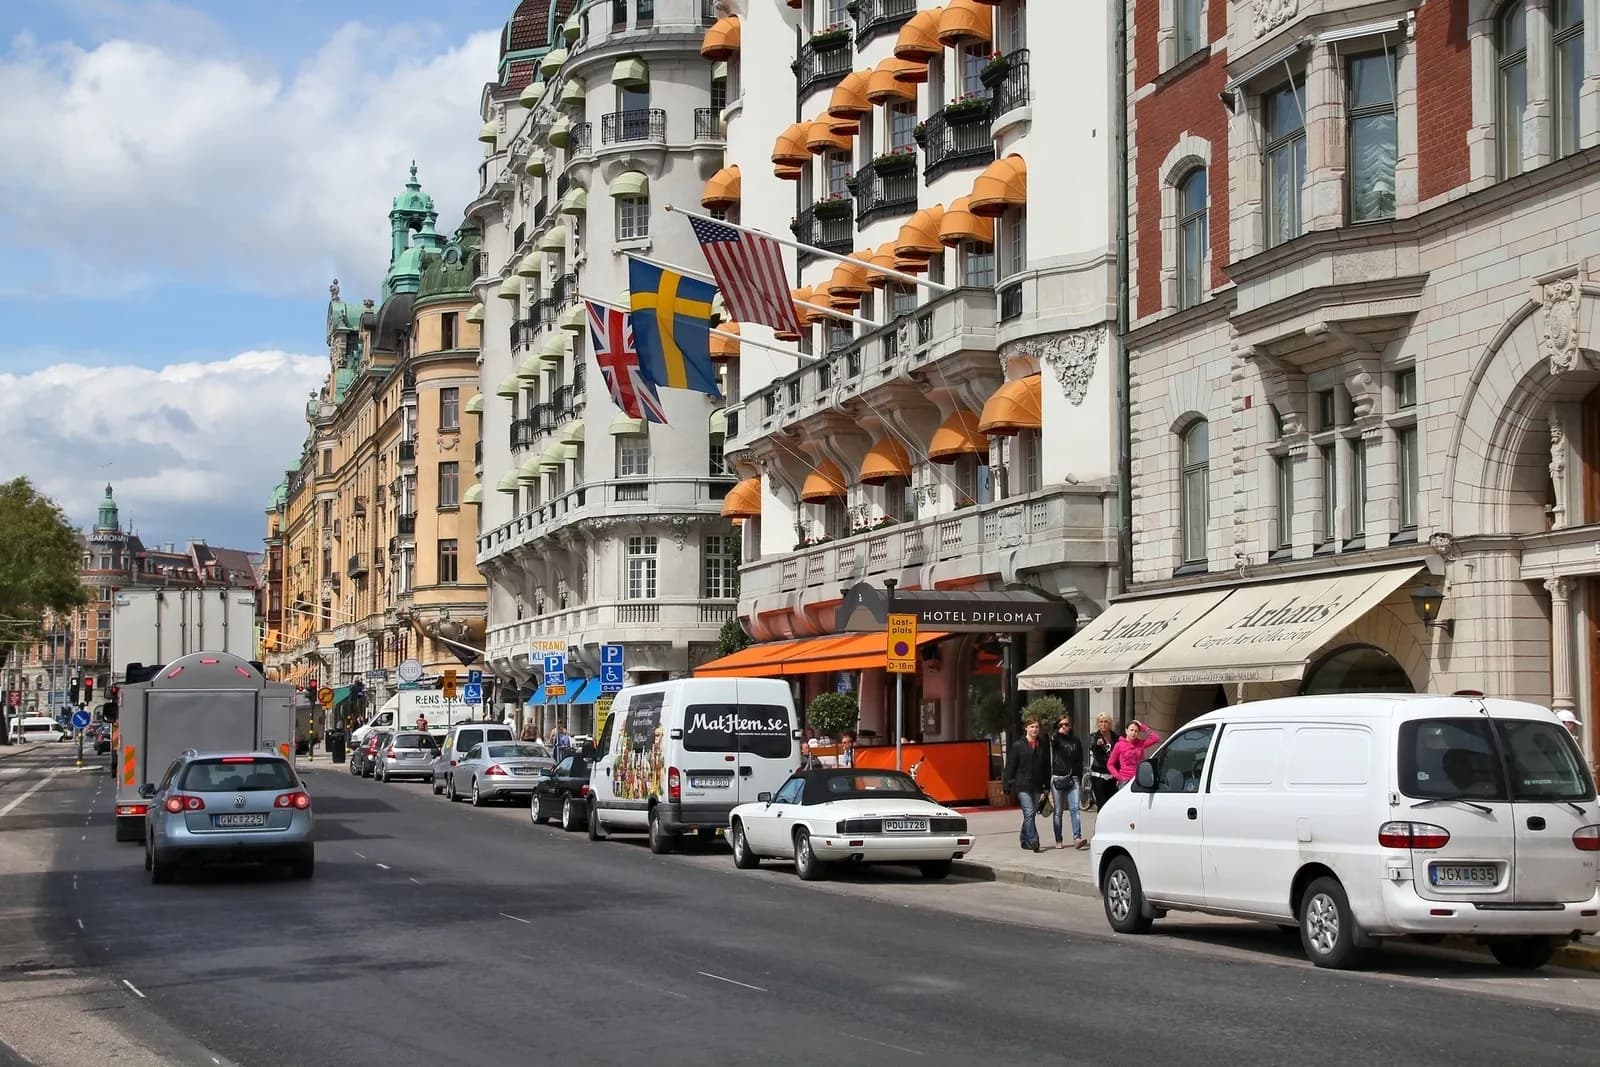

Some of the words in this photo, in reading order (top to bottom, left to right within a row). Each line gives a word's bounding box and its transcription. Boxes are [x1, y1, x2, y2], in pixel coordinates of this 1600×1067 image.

[923, 611, 967, 622] HOTEL
[972, 612, 1042, 623] DIPLOMAT
[532, 640, 565, 651] STRAND
[607, 647, 618, 662] P
[550, 658, 559, 671] P
[472, 672, 479, 682] P
[887, 821, 904, 829] PDU
[910, 821, 925, 829] 728
[1439, 868, 1464, 881] JGX
[1471, 868, 1495, 881] 635
